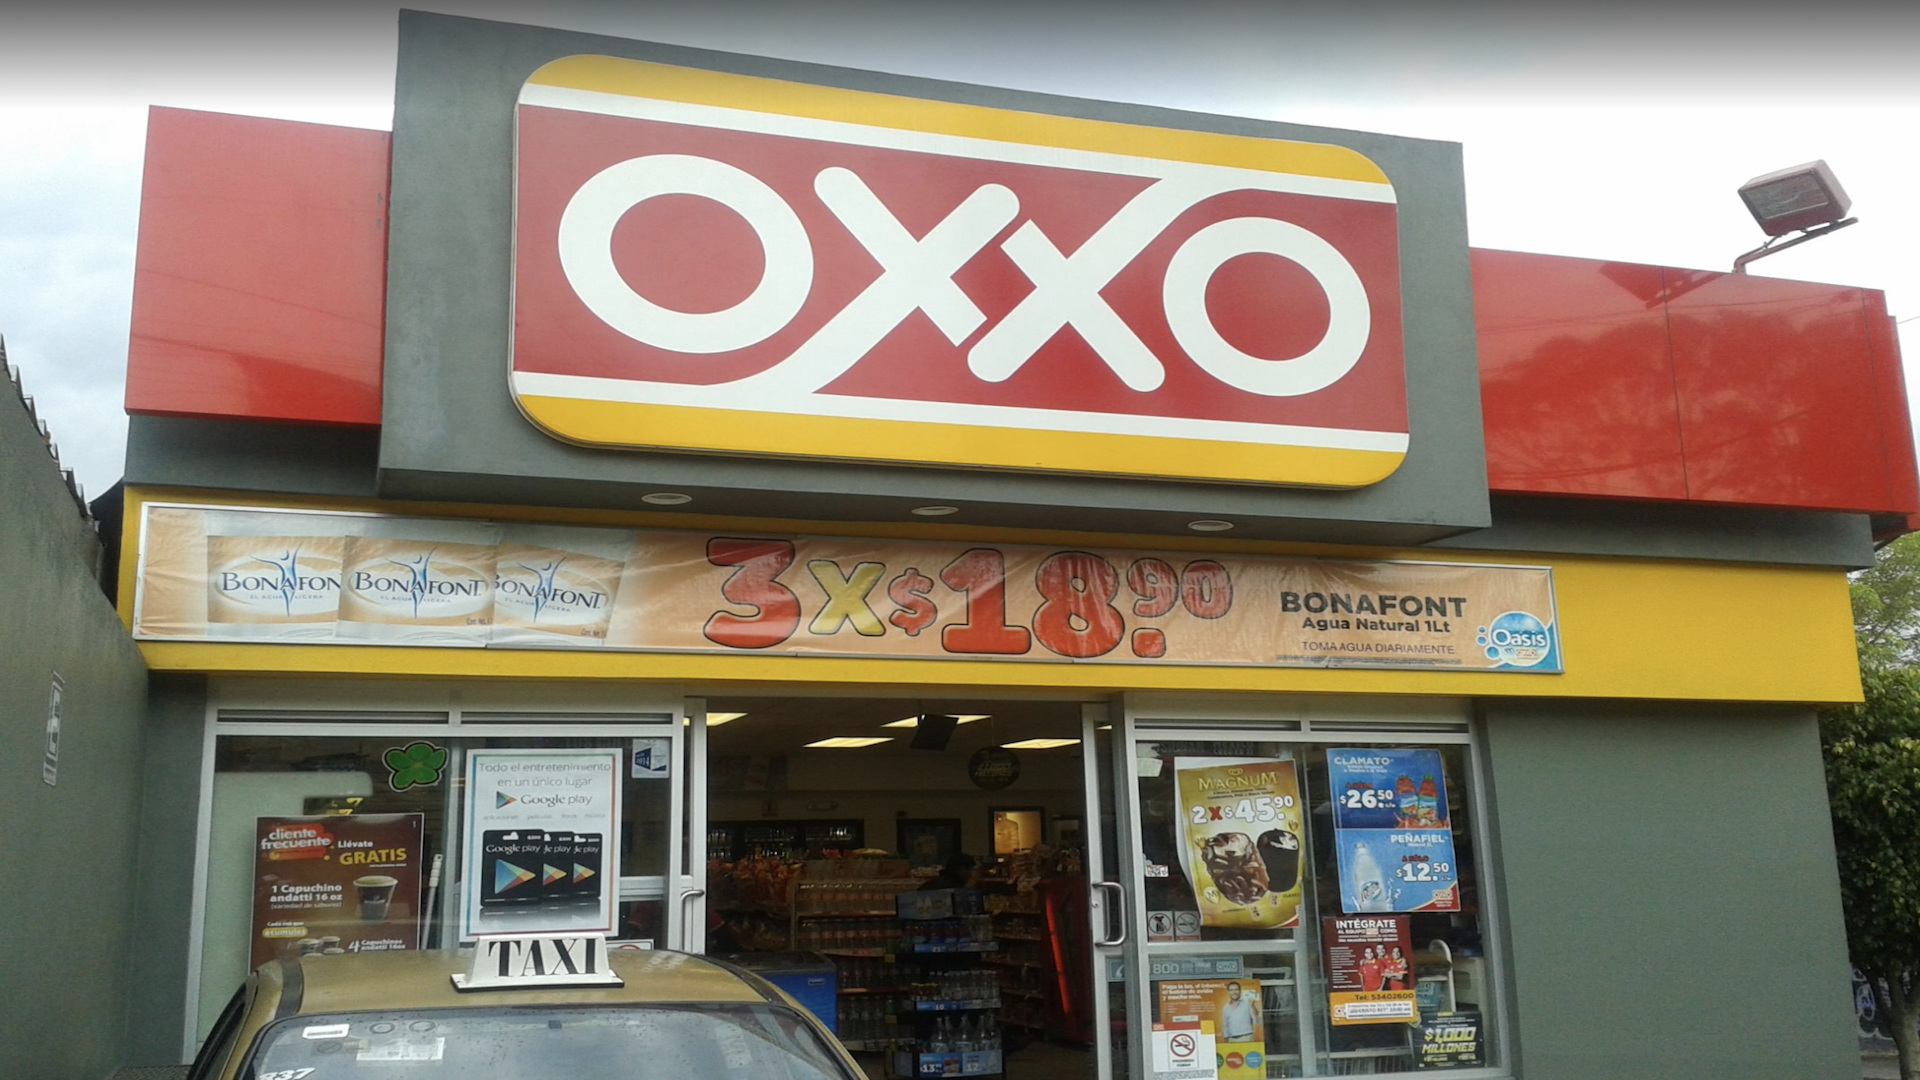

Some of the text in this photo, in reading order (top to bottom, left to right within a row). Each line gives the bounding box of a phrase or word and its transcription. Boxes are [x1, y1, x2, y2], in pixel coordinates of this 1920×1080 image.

[557, 154, 1371, 397] OXXO
[222, 572, 341, 591] BONAFON
[355, 571, 485, 597] BONAFONT
[1281, 591, 1467, 618] BONAFONT
[1302, 617, 1451, 633] Agua Natural 1Lt
[1492, 628, 1546, 647] Oasis
[1302, 641, 1338, 652] TOMA
[1339, 642, 1373, 653] AGUA
[479, 762, 612, 773] Todo el entretenimiento
[1333, 756, 1391, 766] CLAMATO
[497, 777, 594, 789] en un único lugar
[1199, 772, 1277, 791] MAGNUM
[520, 793, 593, 808] Google play
[1339, 789, 1394, 809] $26.50
[268, 828, 317, 840] cliente
[1390, 832, 1446, 844] PEÑAFIEL
[261, 837, 332, 850] frecuente
[338, 839, 374, 848] Llévate
[485, 843, 520, 855] Google
[521, 844, 541, 854] play
[553, 845, 572, 854] play
[583, 846, 600, 854] play
[339, 847, 407, 865] GRATIS
[1395, 862, 1450, 882] $12.50
[271, 883, 342, 895] 1 Capuchino
[270, 893, 313, 902] andatti
[315, 893, 328, 901] 16
[1336, 918, 1396, 929] INTÉGRATE
[348, 940, 360, 953] 4
[488, 938, 600, 978] TAXI
[1421, 1041, 1477, 1055] MILLONES
